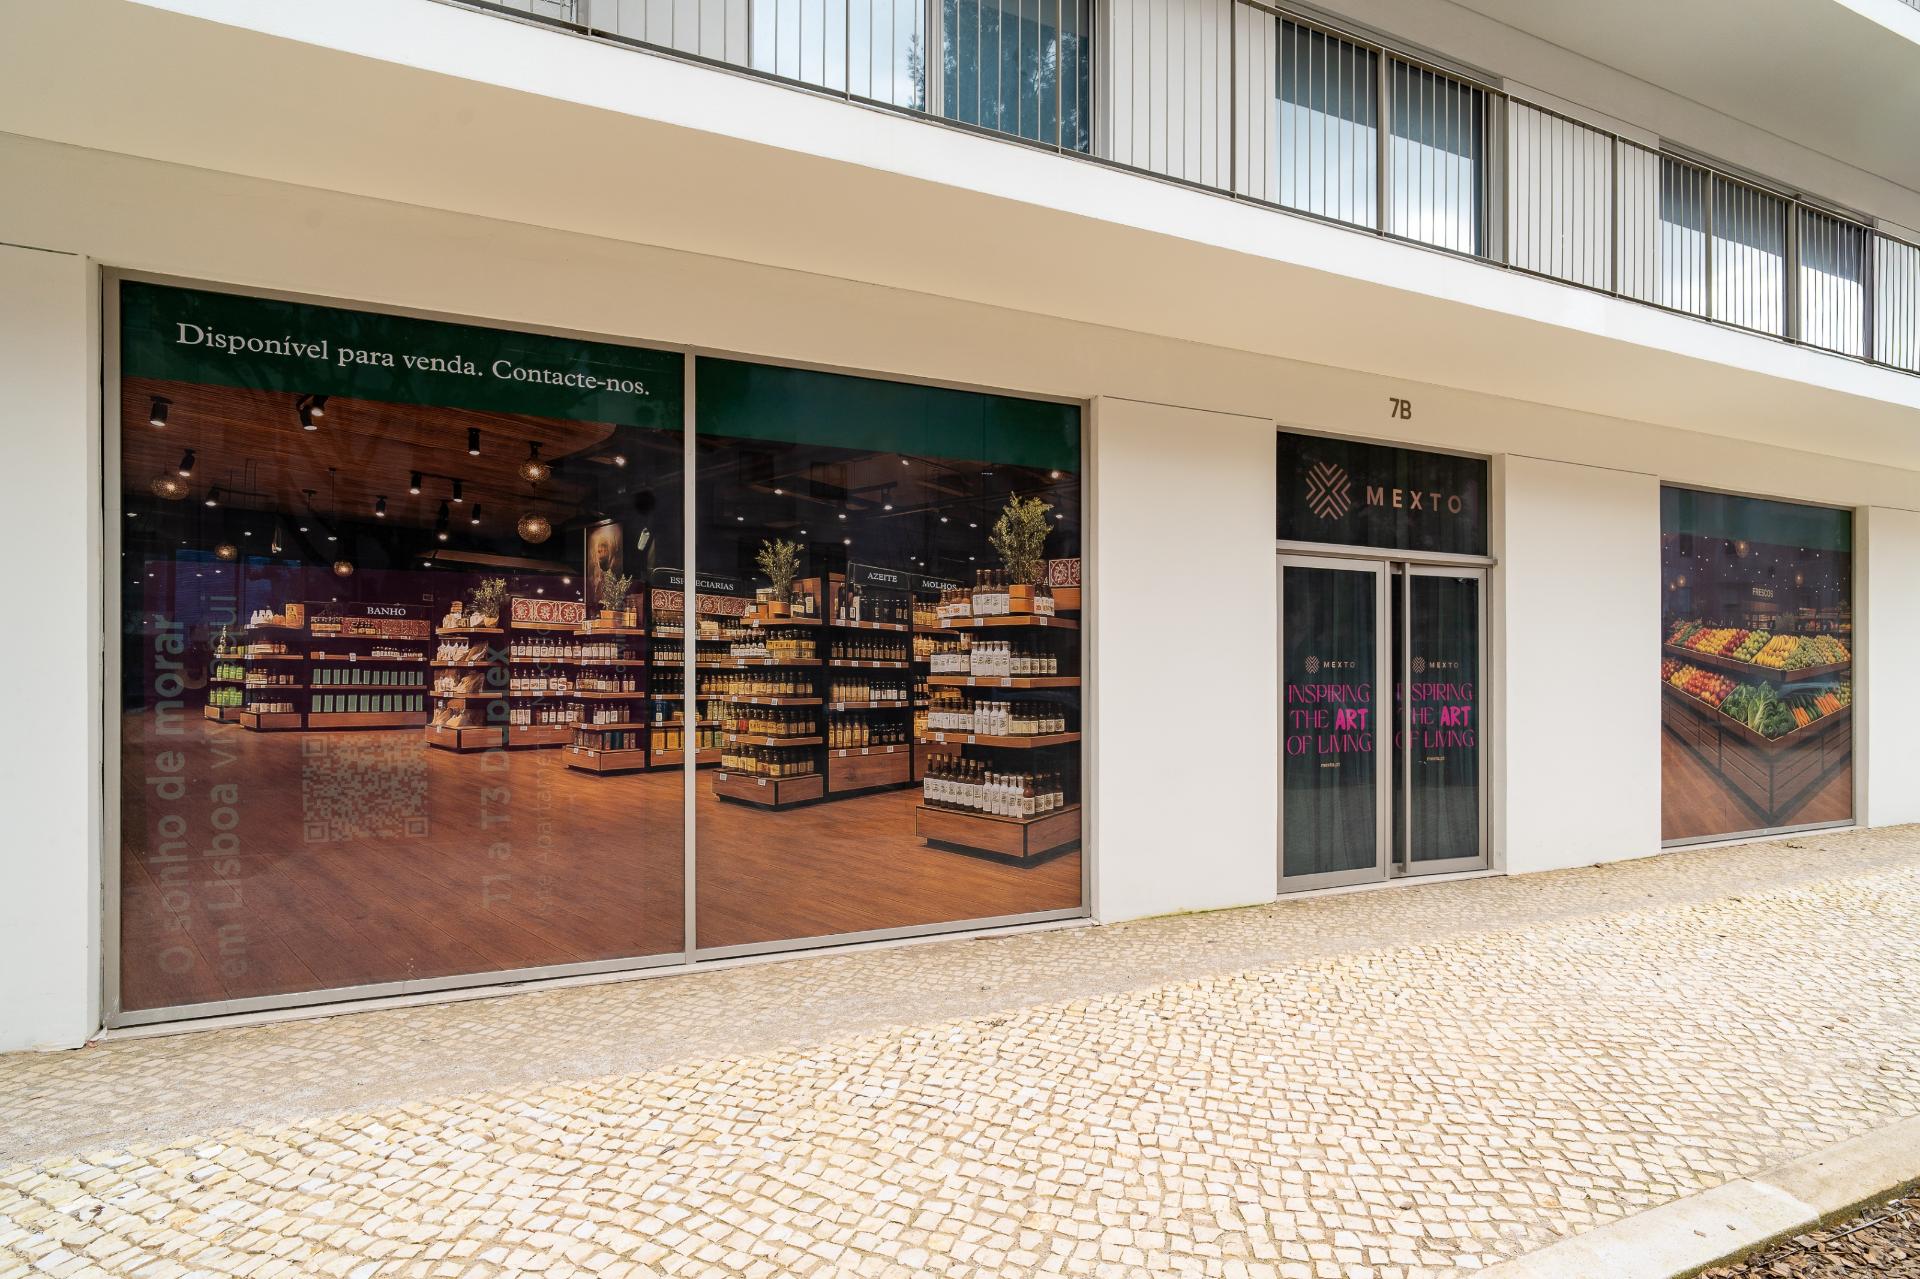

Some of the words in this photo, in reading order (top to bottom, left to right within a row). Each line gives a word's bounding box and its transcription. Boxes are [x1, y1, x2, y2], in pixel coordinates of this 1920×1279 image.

[176, 322, 329, 360] Disponível
[337, 347, 395, 367] para
[402, 354, 483, 377] venda.
[492, 359, 650, 395] Contacte-nos.
[1389, 397, 1412, 420] 7B
[1366, 485, 1462, 514] MEXTO
[867, 572, 898, 583] AZEITE
[922, 580, 957, 591] MOLHOS
[367, 606, 407, 616] BANHO
[152, 613, 186, 736] morar
[1323, 661, 1356, 669] MEXTO
[1429, 661, 1459, 669] MEXTO
[1288, 683, 1372, 704] INSPIRING
[1397, 682, 1473, 701] ISPIRING
[1289, 709, 1330, 729] THE
[1335, 708, 1369, 730] ART
[1440, 705, 1472, 727] ART
[1286, 735, 1312, 756] OF
[1318, 733, 1373, 754] LIVING
[1424, 729, 1475, 749] LIVING
[146, 750, 186, 800] de
[480, 786, 511, 830] T3
[203, 783, 242, 910] Lisboa
[146, 815, 193, 933] sonho
